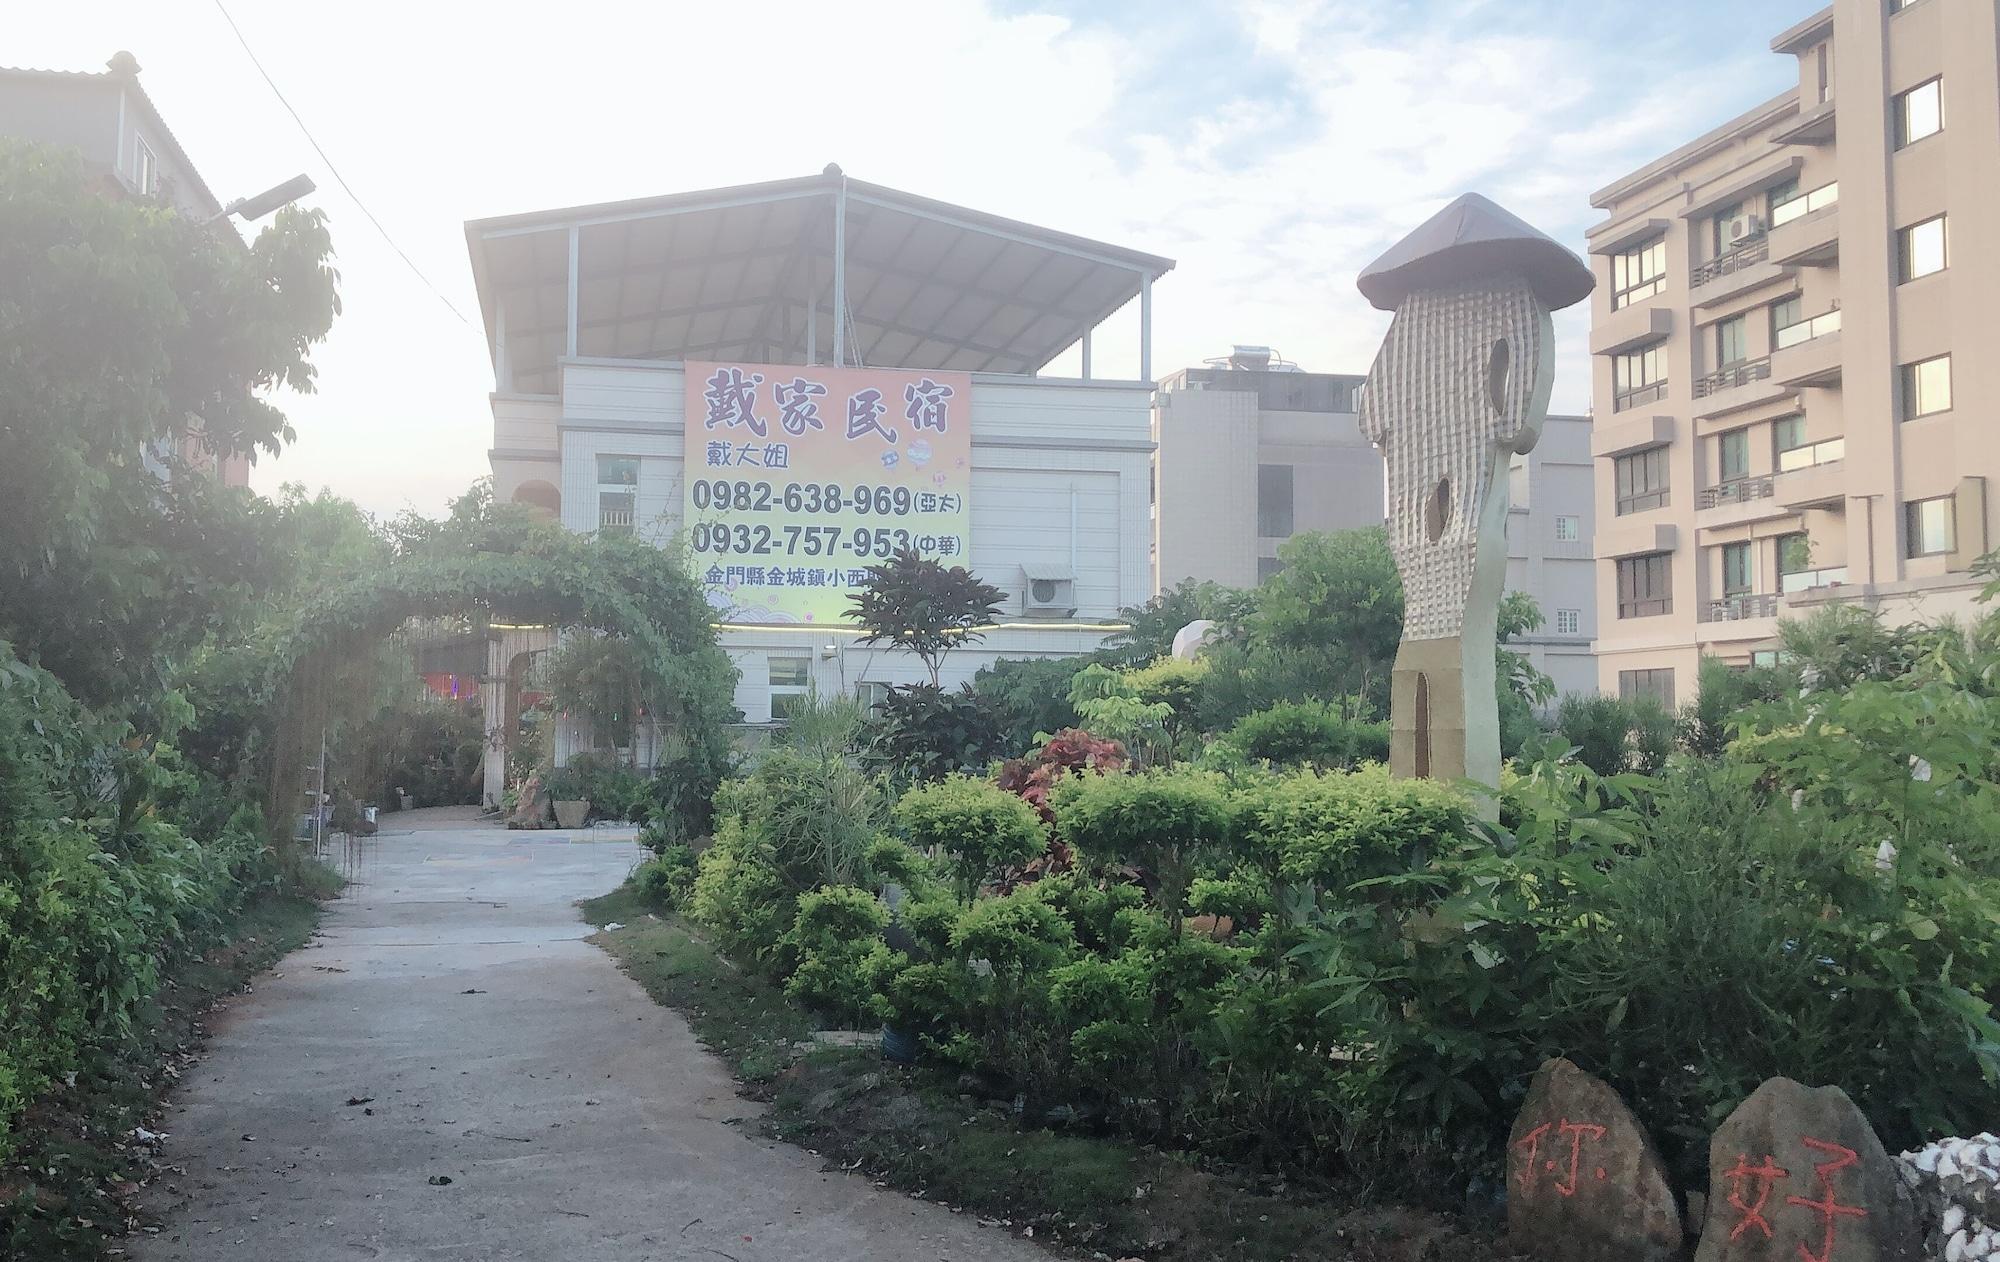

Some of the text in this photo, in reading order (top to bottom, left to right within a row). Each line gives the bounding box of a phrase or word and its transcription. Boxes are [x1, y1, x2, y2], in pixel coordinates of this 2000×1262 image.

[704, 368, 953, 444] 戴家民宿
[706, 440, 789, 470] 戴大姐
